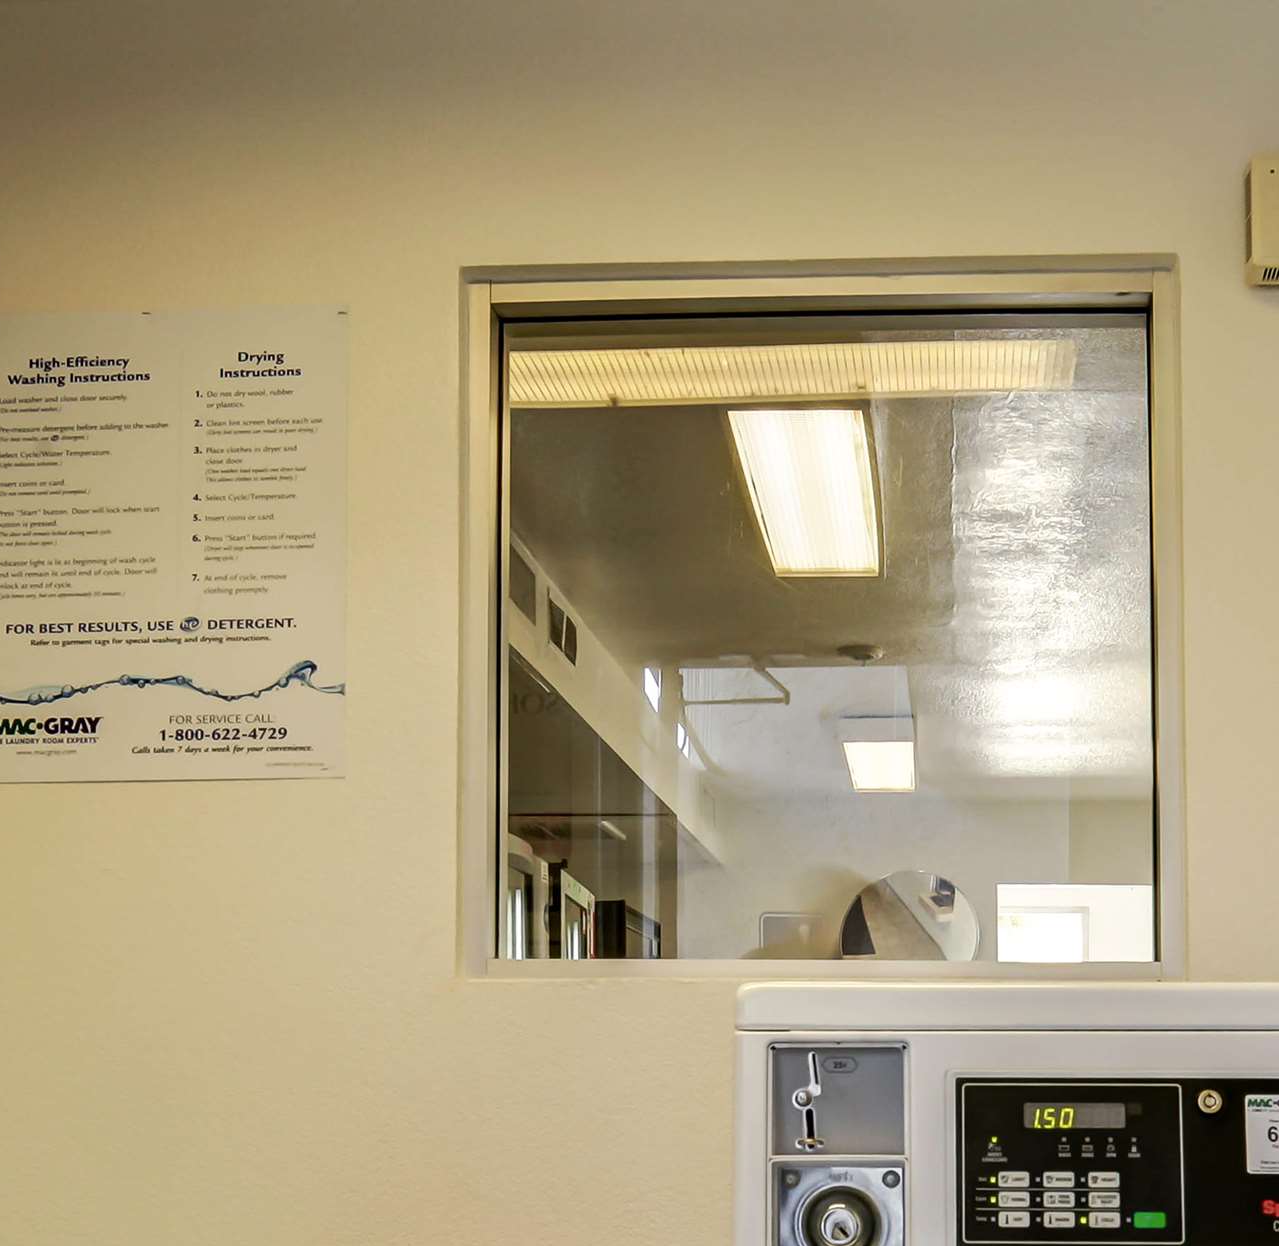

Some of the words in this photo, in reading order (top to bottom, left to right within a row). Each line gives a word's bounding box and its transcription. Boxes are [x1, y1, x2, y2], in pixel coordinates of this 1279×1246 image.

[29, 356, 129, 372] High-Efficiency
[238, 351, 285, 364] Drying
[220, 366, 302, 378] Instructions
[8, 374, 65, 387] Washing
[70, 371, 150, 383] Instructions
[6, 624, 34, 634] FOR
[39, 623, 73, 633] BEST
[78, 622, 142, 633] RESULTS,
[148, 620, 173, 631] USE
[208, 618, 296, 630] DETERGENT.
[170, 715, 192, 724] FOR
[196, 714, 241, 724] SERVICE
[160, 727, 287, 741] 1-800-622-4729
[185, 746, 202, 754] days
[233, 745, 244, 754] for
